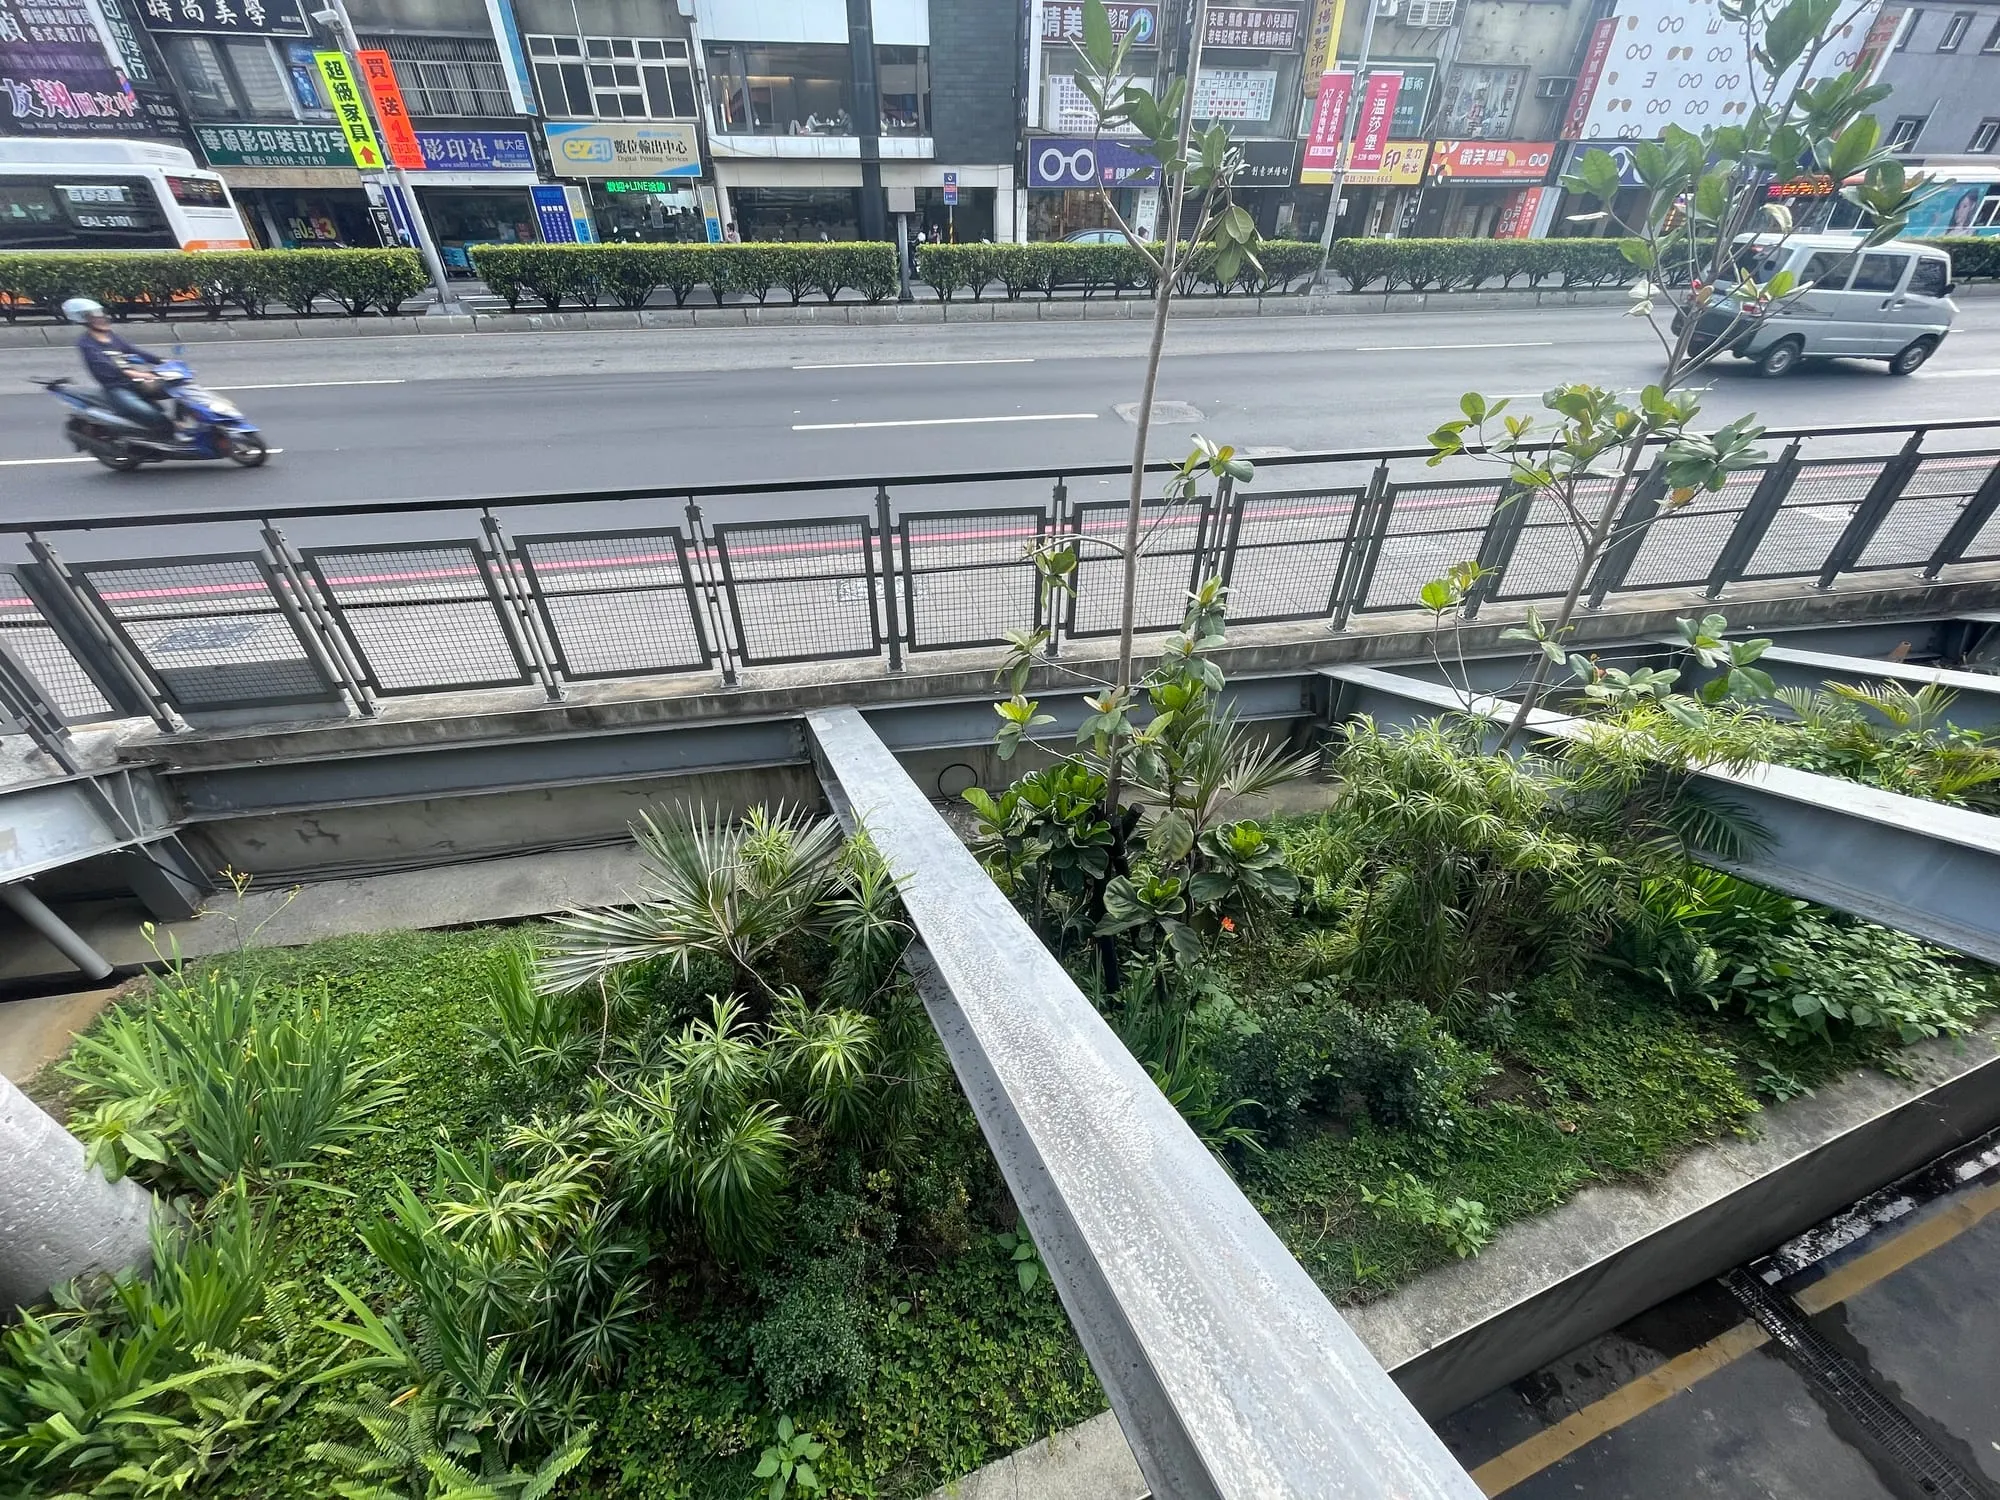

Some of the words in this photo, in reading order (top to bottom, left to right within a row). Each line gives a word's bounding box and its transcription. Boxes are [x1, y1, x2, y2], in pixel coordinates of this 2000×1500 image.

[146, 0, 266, 26] 時尚美學
[0, 78, 140, 118] 友翔圖文中
[324, 61, 370, 142] 超級家具
[1363, 98, 1386, 151] 溫莎堡
[200, 129, 348, 153] 華碩影印裝訂打字
[614, 139, 688, 154] 數位輸出中心
[617, 155, 637, 163] Digital
[640, 155, 663, 163] Printing
[665, 155, 689, 163] Services
[1384, 148, 1401, 172] 印
